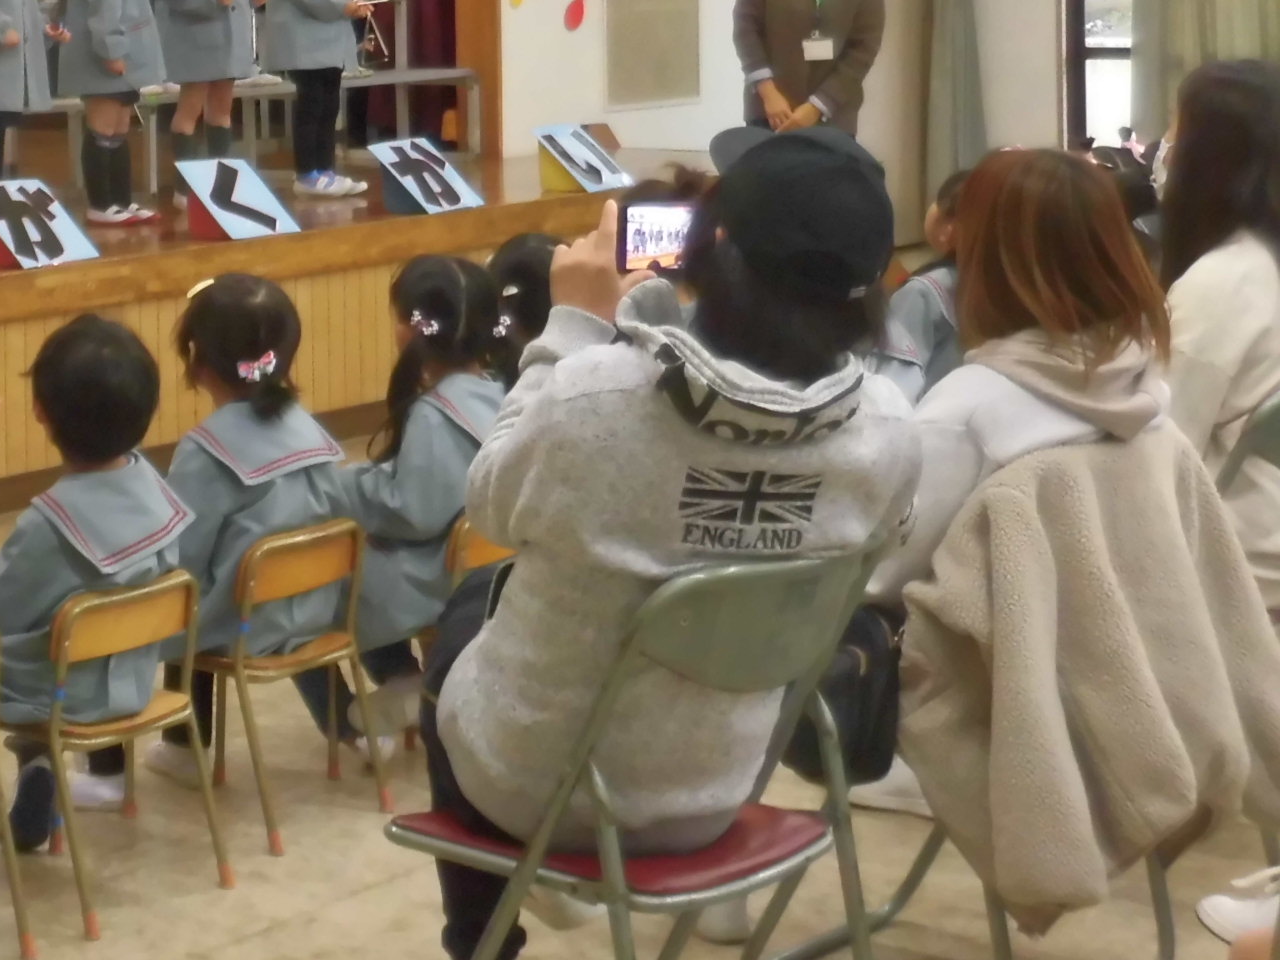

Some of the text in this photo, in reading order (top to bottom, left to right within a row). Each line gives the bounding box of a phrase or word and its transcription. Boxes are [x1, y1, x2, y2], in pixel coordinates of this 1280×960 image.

[387, 140, 462, 208] か
[540, 129, 621, 186] い
[211, 161, 278, 232] く
[681, 523, 803, 550] ENGLAND
